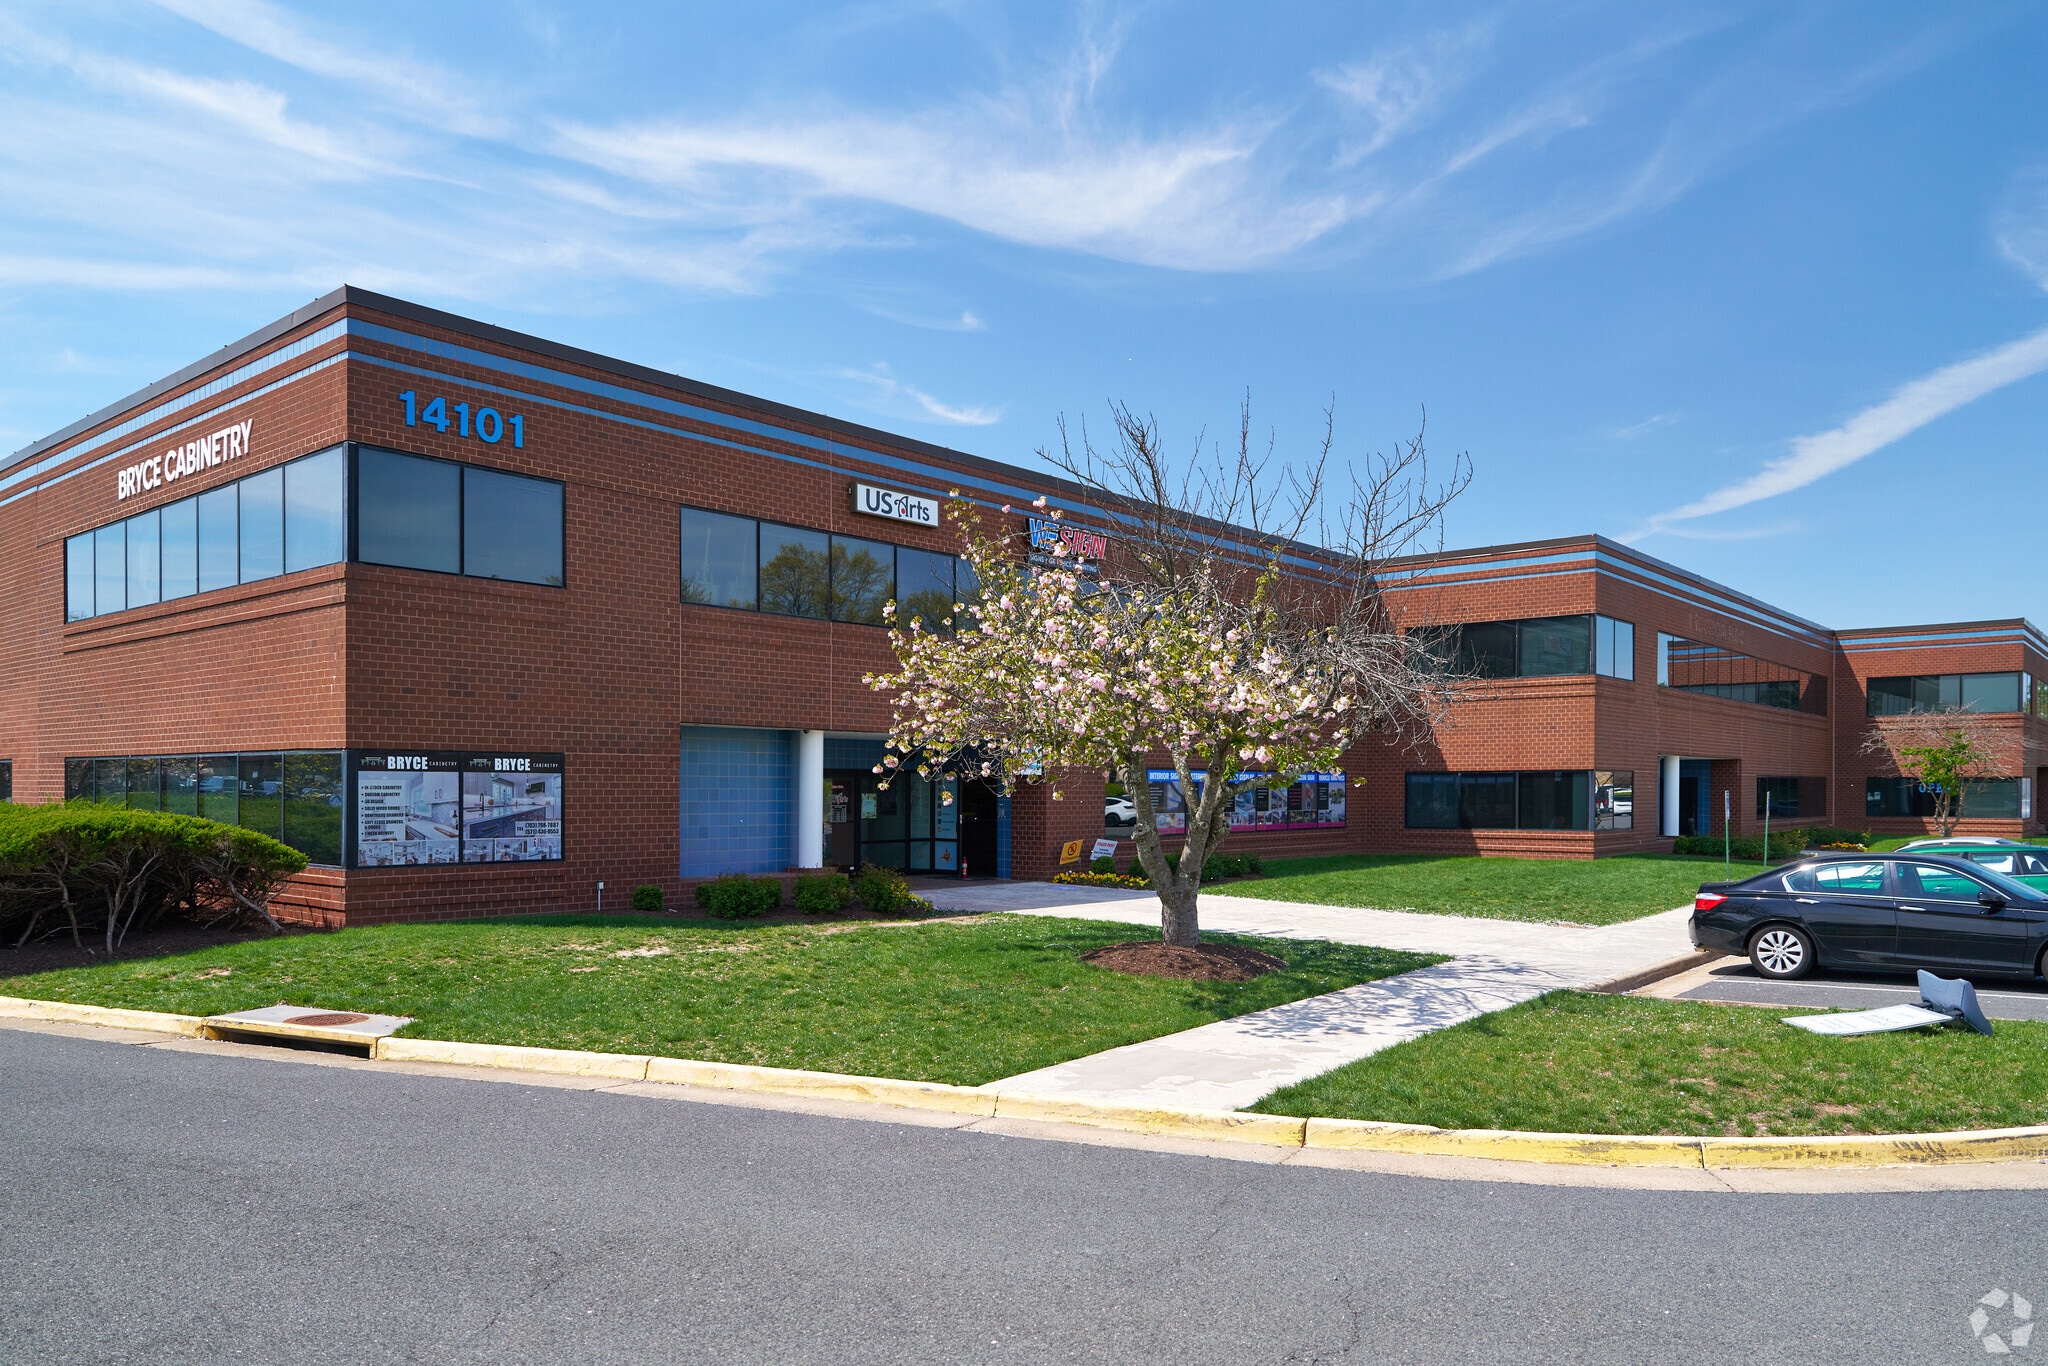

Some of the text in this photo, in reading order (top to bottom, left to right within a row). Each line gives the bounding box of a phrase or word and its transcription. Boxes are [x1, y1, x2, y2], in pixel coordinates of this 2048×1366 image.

[398, 390, 524, 448] 14101
[118, 418, 253, 500] BRYCE CABINETRY
[865, 488, 930, 521] US Arts
[387, 756, 428, 770] BRYCE
[494, 758, 531, 771] BRYCE
[1149, 772, 1181, 780] INTERIOR SIG
